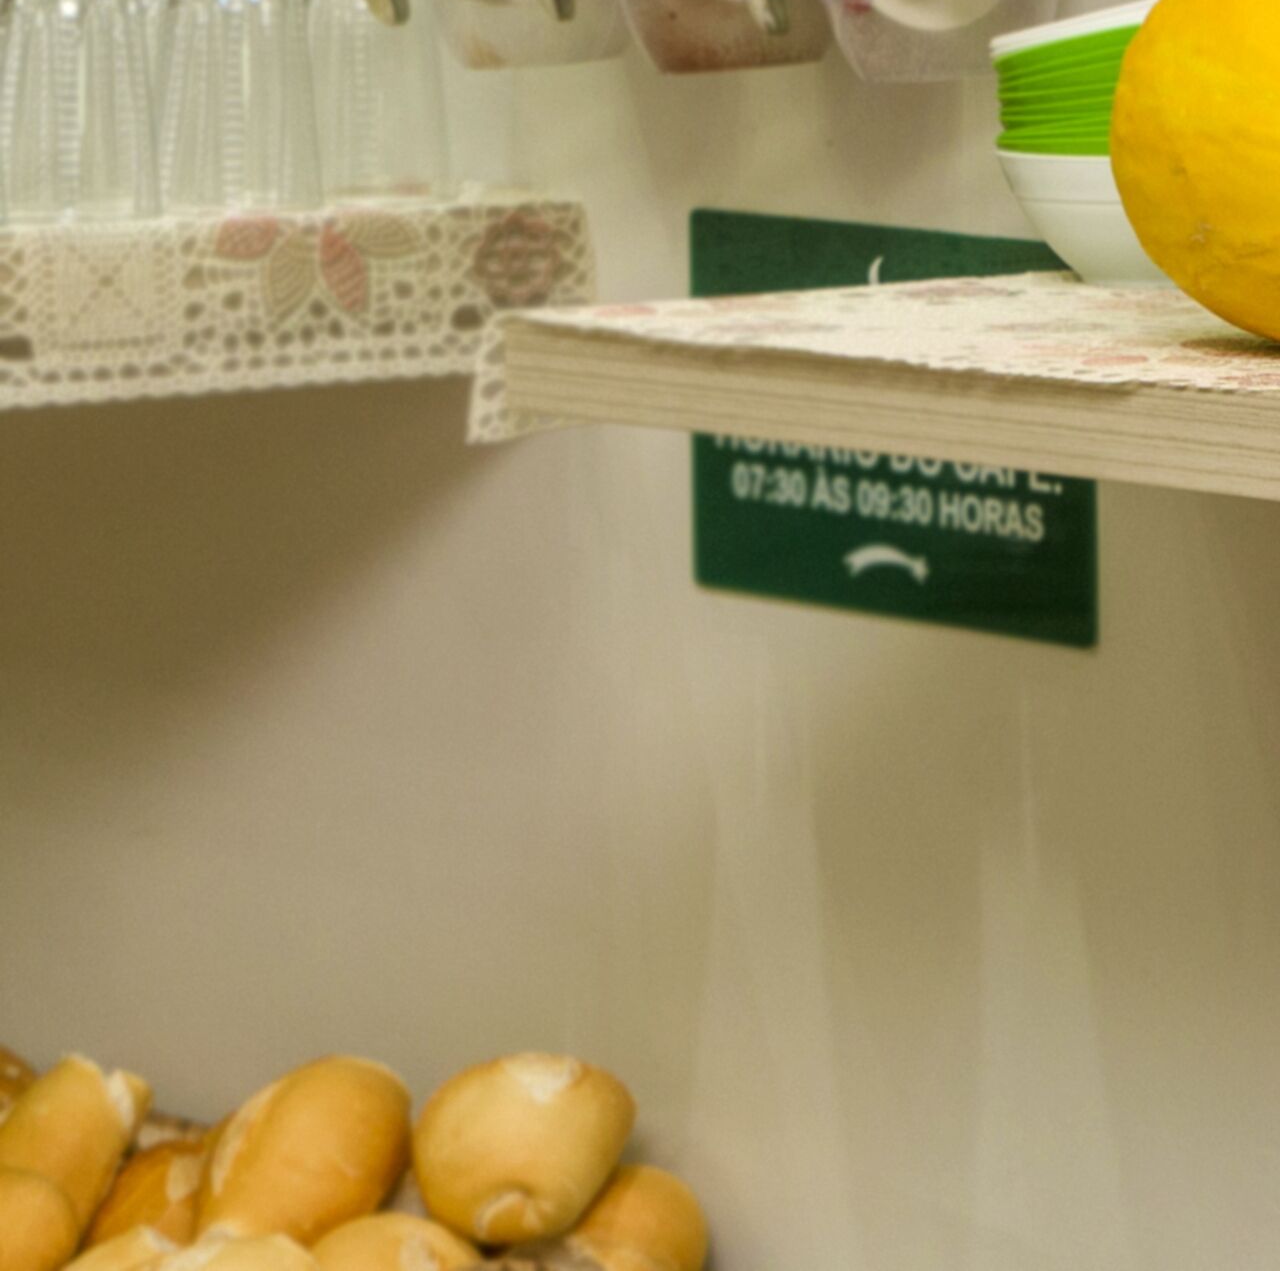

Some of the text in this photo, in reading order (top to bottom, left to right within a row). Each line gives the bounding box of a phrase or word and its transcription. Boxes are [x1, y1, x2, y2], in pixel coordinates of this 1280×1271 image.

[732, 460, 807, 507] 07:30
[857, 479, 933, 525] 09:30
[938, 490, 1045, 542] HORAS
